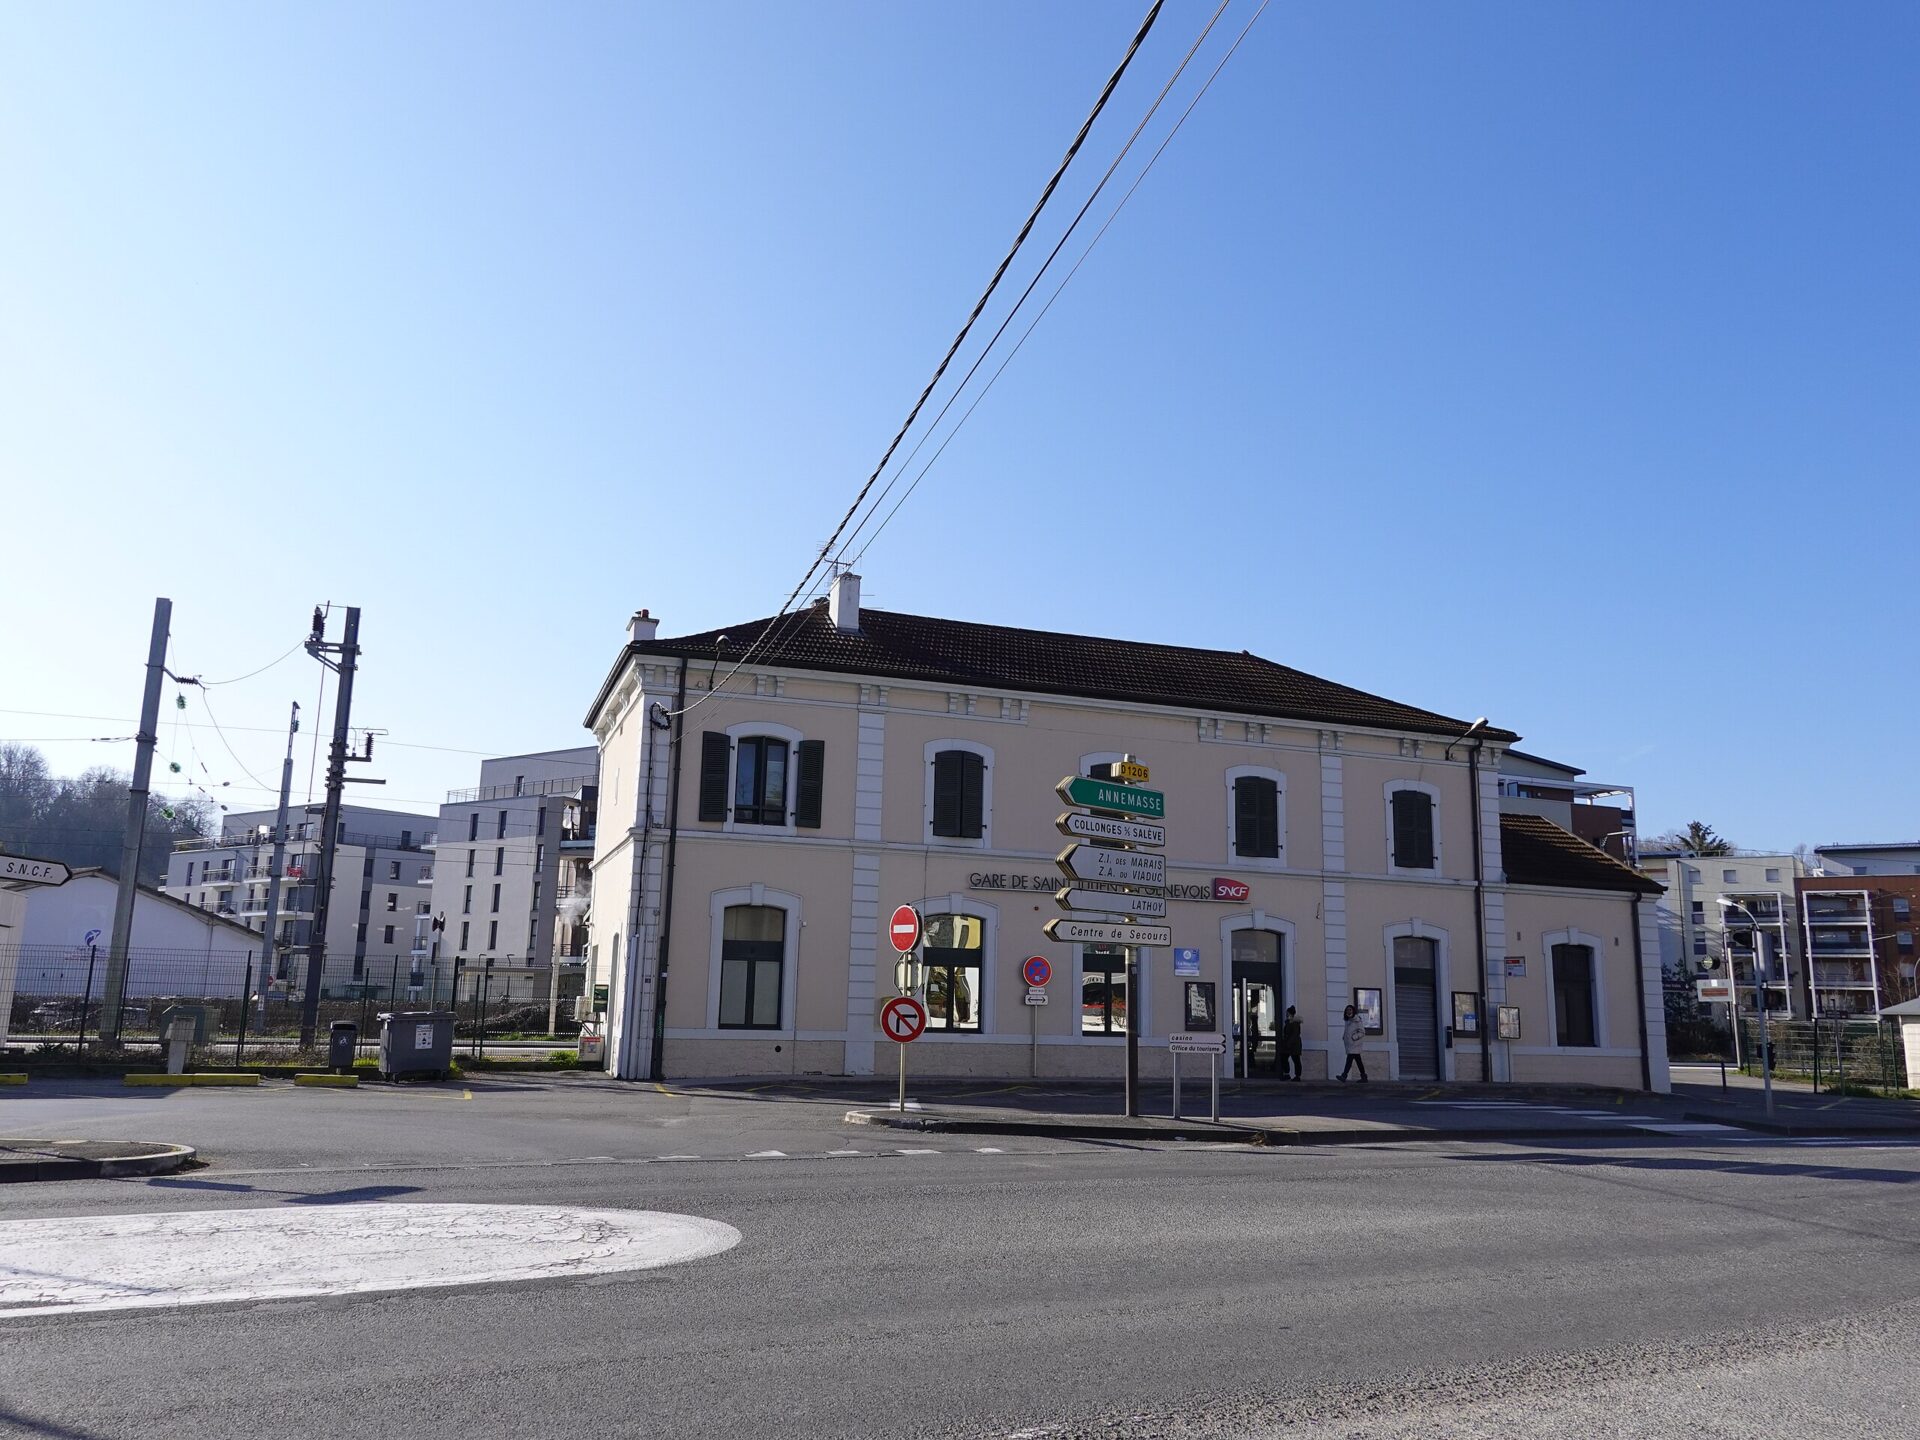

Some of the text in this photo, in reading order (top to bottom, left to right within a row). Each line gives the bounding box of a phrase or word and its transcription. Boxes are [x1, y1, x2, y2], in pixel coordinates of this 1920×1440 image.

[1098, 788, 1161, 810] ANNEMASSE
[1074, 819, 1122, 835] COLLONGES
[1132, 827, 1162, 841] SALÈVE
[1098, 852, 1163, 870] Z.I. DES MARAIS
[6, 862, 54, 879] S.N.C.F.
[1098, 866, 1116, 877] Z.A.
[1132, 870, 1163, 882] VIADUC
[969, 872, 1007, 888] GARE
[1012, 875, 1029, 889] DE
[1033, 876, 1070, 891] SAINT
[1217, 886, 1248, 897] SNCF
[1131, 899, 1163, 912] LATHOY
[1070, 925, 1168, 941] Centre de Secours
